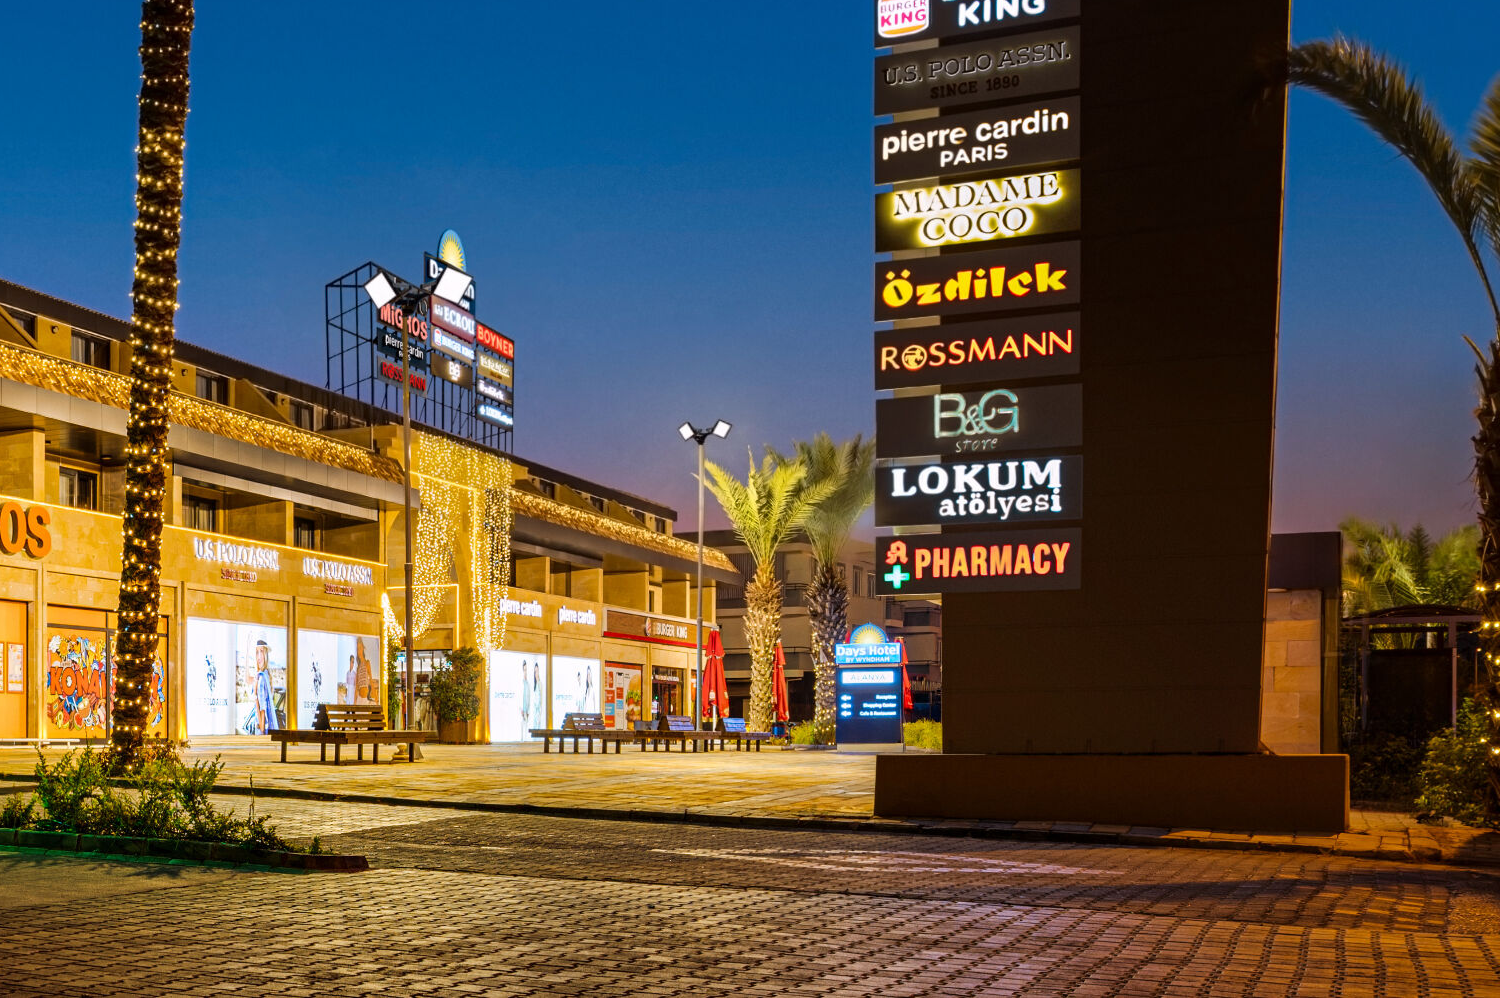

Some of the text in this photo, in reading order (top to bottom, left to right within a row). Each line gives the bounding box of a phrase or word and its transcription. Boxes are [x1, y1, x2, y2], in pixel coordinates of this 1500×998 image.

[880, 9, 927, 28] KING
[883, 40, 1071, 86] U.S. POLO ASSN.
[930, 80, 978, 99] SINCE
[882, 110, 1069, 160] pierre cardin
[940, 143, 1009, 168] PARIS
[893, 171, 1061, 218] MADAME
[922, 207, 1028, 242] COCO
[882, 261, 1067, 308] Özdilek
[477, 325, 514, 358] BOYNER
[881, 329, 1073, 371] ROSSMANN
[382, 362, 426, 392] ROSSANN
[934, 389, 1020, 439] B&G
[955, 436, 999, 453] store
[891, 458, 1064, 497] LOKUM
[938, 488, 1063, 520] atölyesi
[217, 541, 249, 566] POLO
[914, 542, 1071, 579] PHARMACY
[322, 558, 349, 581] POLO
[500, 599, 542, 618] pierre cardin
[558, 606, 596, 625] pierre cardin
[656, 622, 688, 639] BURGER KING
[836, 645, 900, 657] Days Hotel
